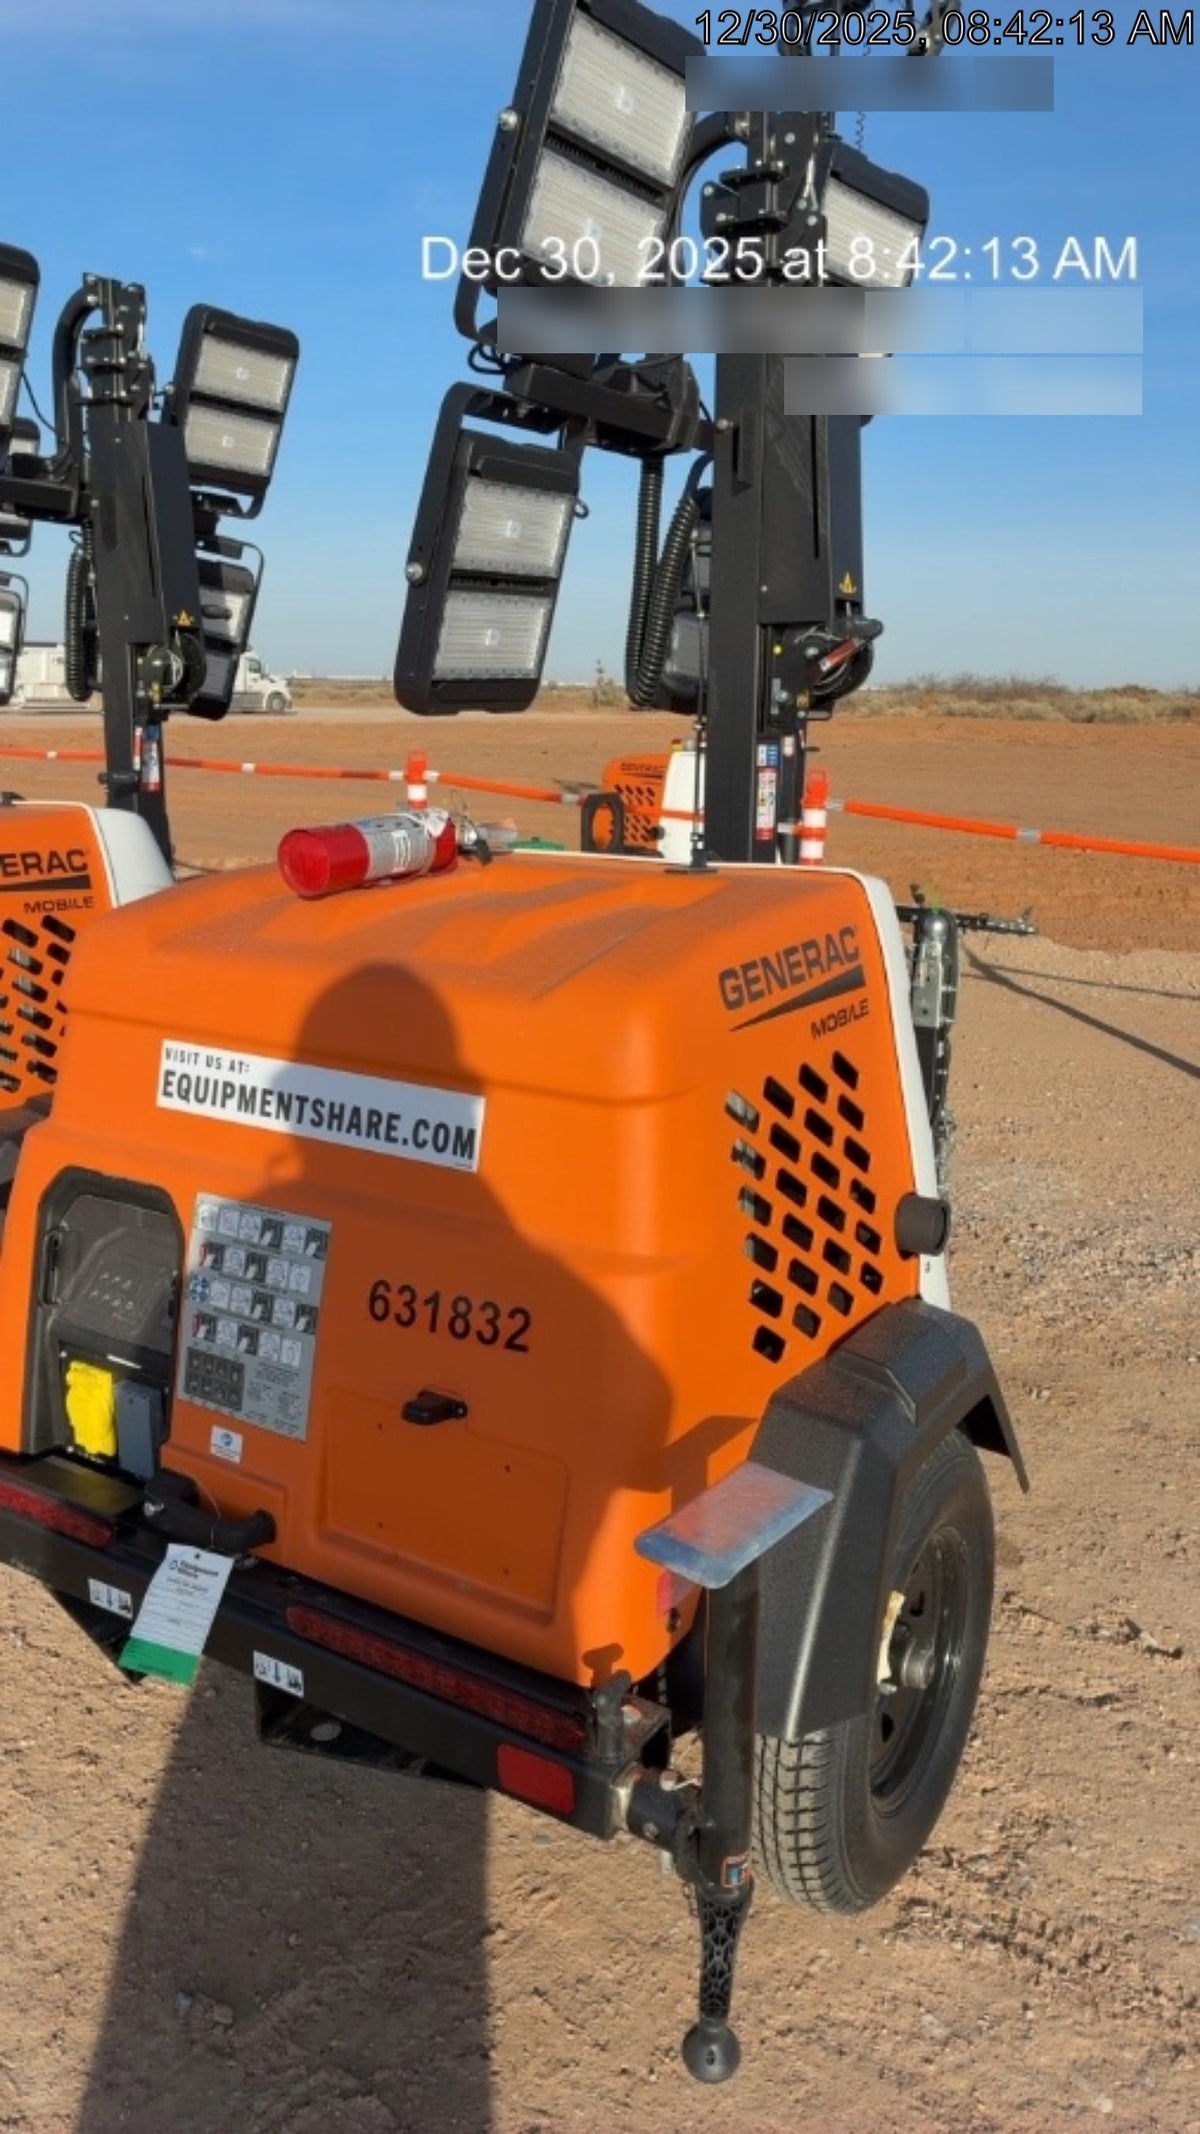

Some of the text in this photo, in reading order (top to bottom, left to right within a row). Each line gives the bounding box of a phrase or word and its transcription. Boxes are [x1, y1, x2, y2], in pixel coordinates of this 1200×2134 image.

[23, 896, 95, 914] MOBILE
[718, 926, 861, 1011] GENERAC
[810, 998, 870, 1040] MOBILE
[165, 1047, 250, 1075] VISIT US AT:
[162, 1068, 478, 1160] EQUIPMENTSHARE.COM
[368, 1279, 532, 1353] 631832
